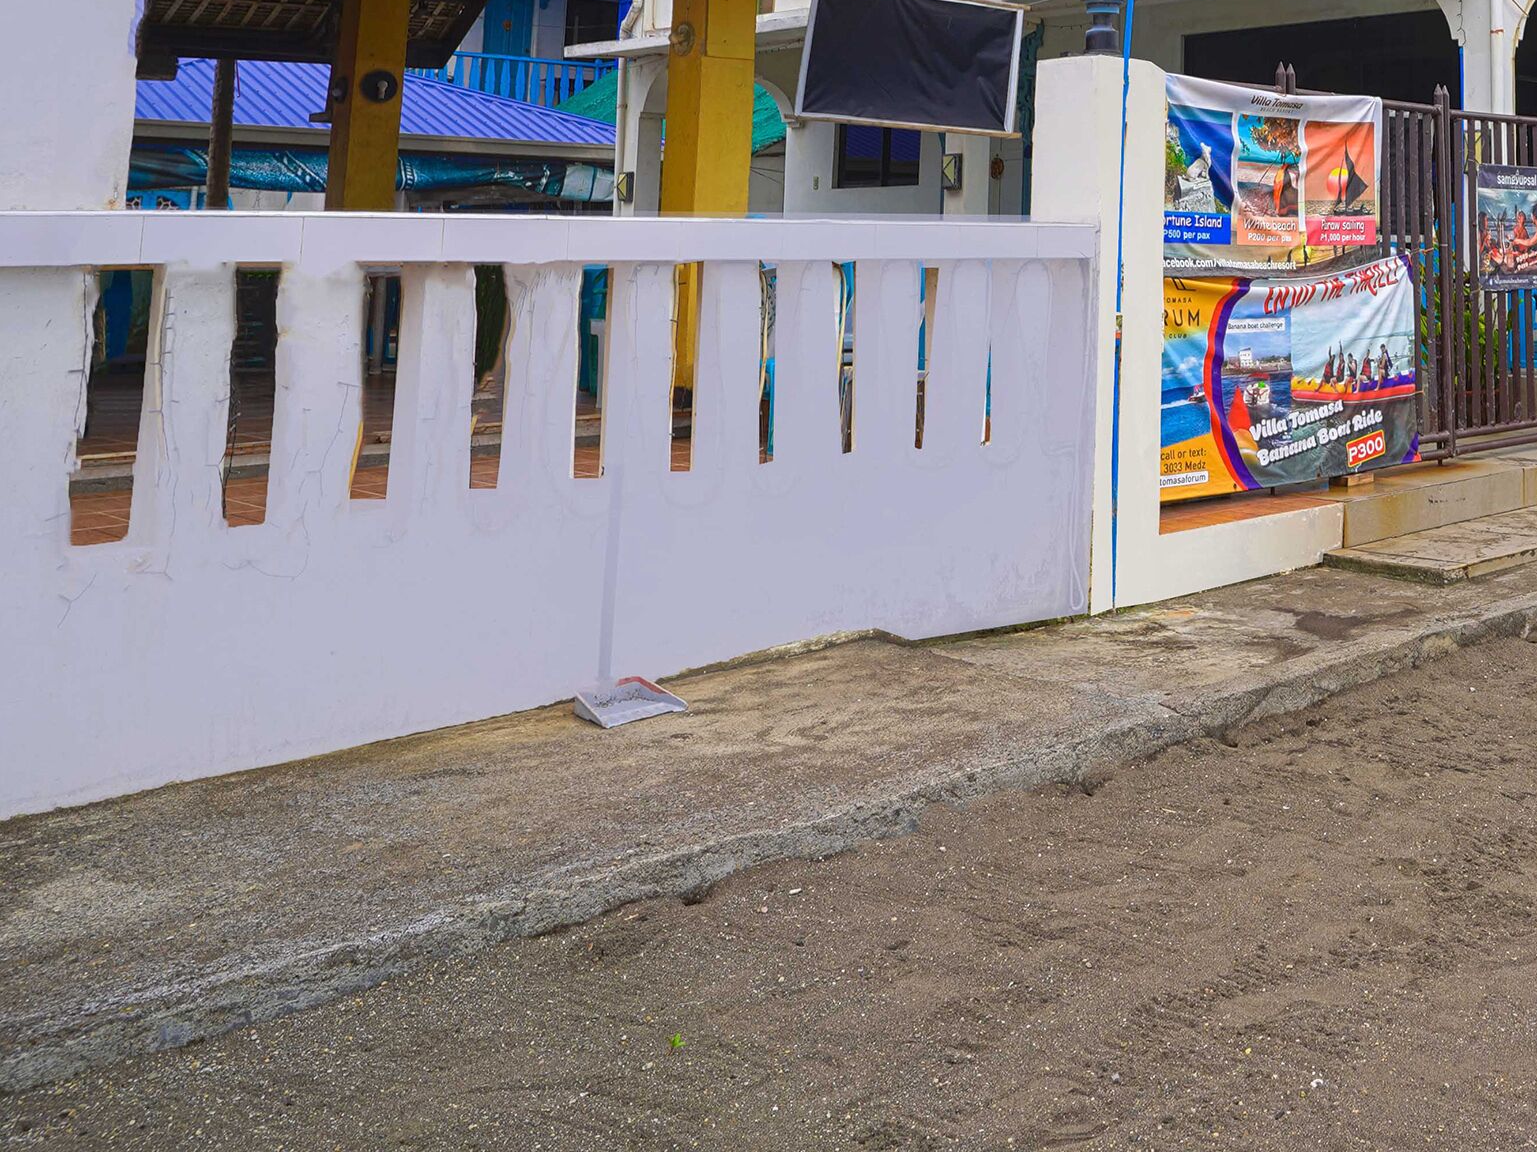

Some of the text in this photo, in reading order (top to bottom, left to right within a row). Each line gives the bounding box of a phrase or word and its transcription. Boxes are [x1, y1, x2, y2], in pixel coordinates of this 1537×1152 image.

[1250, 95, 1303, 109] Villa Tomasa
[1164, 214, 1223, 228] ortune Island
[1243, 218, 1297, 232] White beach
[1342, 218, 1366, 233] sailing
[1163, 229, 1211, 242] P500 per pax
[1247, 232, 1265, 241] P200
[1352, 232, 1366, 241] hour
[1163, 257, 1297, 270] acebook.com/villatomasabeachresort
[1164, 309, 1200, 327] RUM
[1260, 321, 1284, 329] challenge
[1249, 400, 1344, 441] Villa Tomasa
[1256, 409, 1384, 467] Banana Boat Ride
[1161, 447, 1207, 460] call or text:
[1348, 436, 1384, 463] P300
[1184, 460, 1206, 470] Medz
